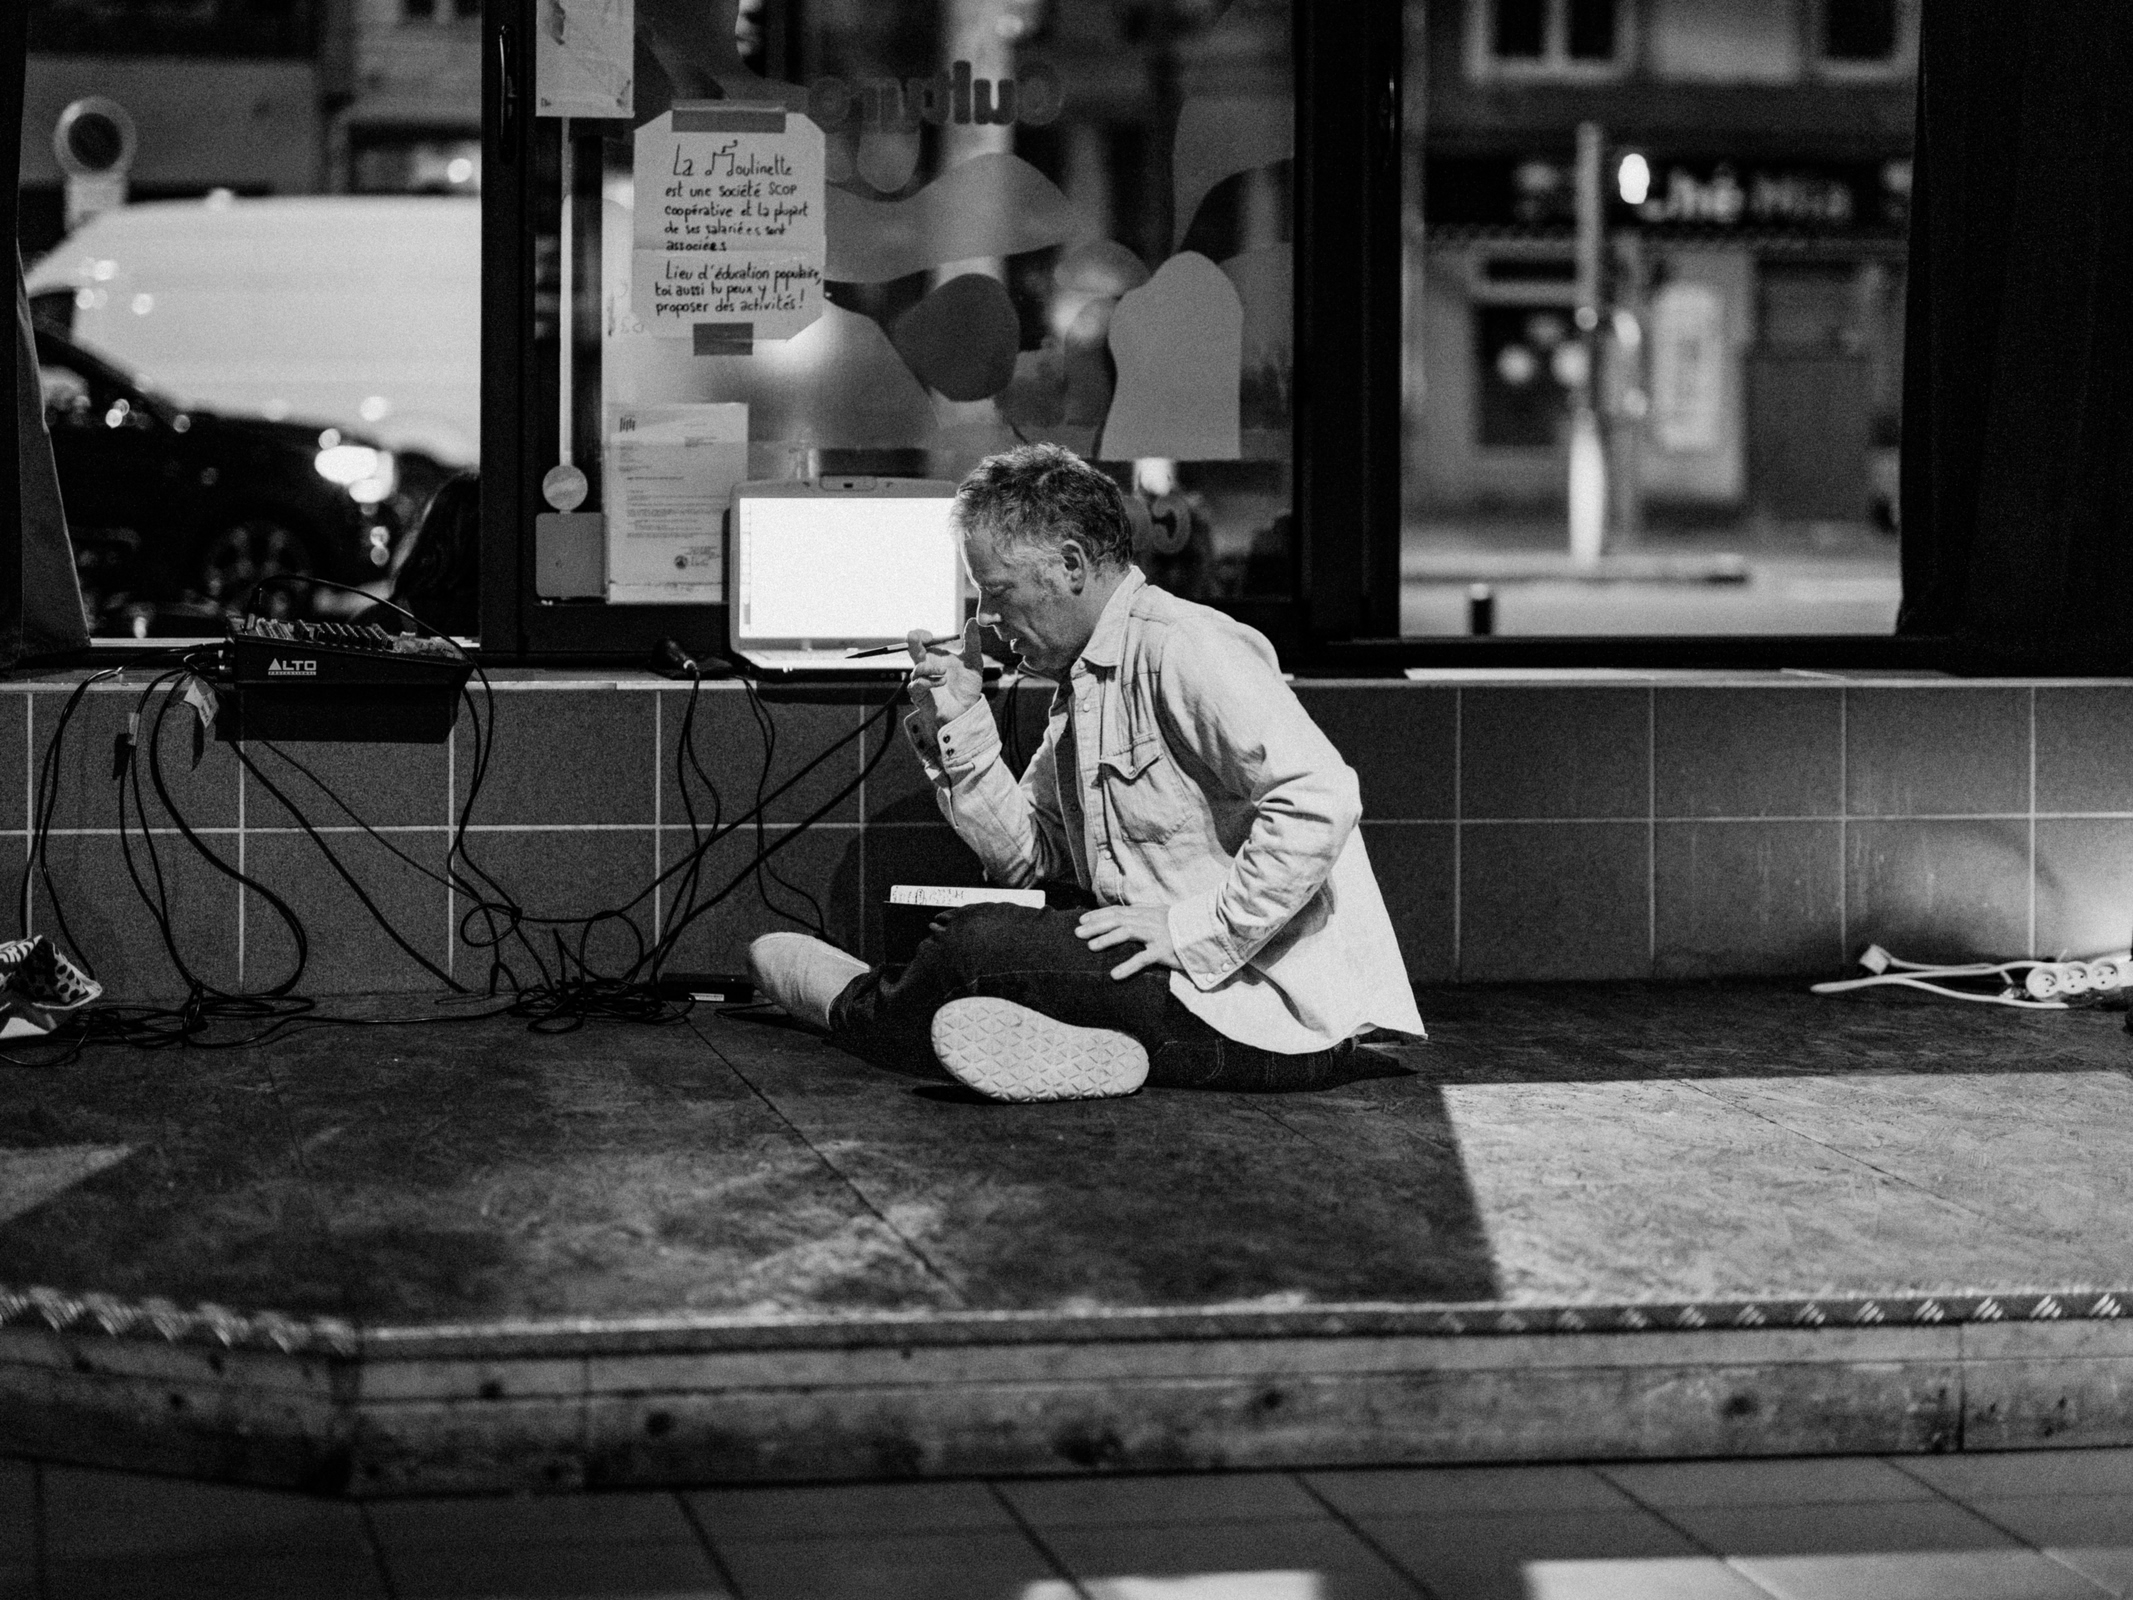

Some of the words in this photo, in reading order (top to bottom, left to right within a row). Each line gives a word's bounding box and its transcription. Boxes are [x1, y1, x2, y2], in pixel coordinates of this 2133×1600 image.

[672, 143, 694, 176] La
[704, 139, 793, 177] Moulinette
[665, 181, 683, 198] est
[690, 187, 712, 198] une
[719, 180, 762, 198] société
[769, 181, 798, 197] SCOP
[664, 201, 734, 223] coopérative
[740, 200, 752, 217] et
[773, 201, 809, 226] plupart
[664, 220, 679, 234] de
[685, 224, 702, 234] ses
[765, 222, 786, 236] sont
[665, 260, 694, 281] Lieu
[697, 261, 771, 281] d'éducation
[655, 281, 672, 297] toi
[675, 283, 705, 297] aussi
[711, 280, 723, 295] tu
[726, 285, 753, 302] peux
[757, 285, 767, 302] y
[655, 302, 710, 319] proposer
[715, 299, 735, 313] des
[268, 657, 317, 671] ALTO
